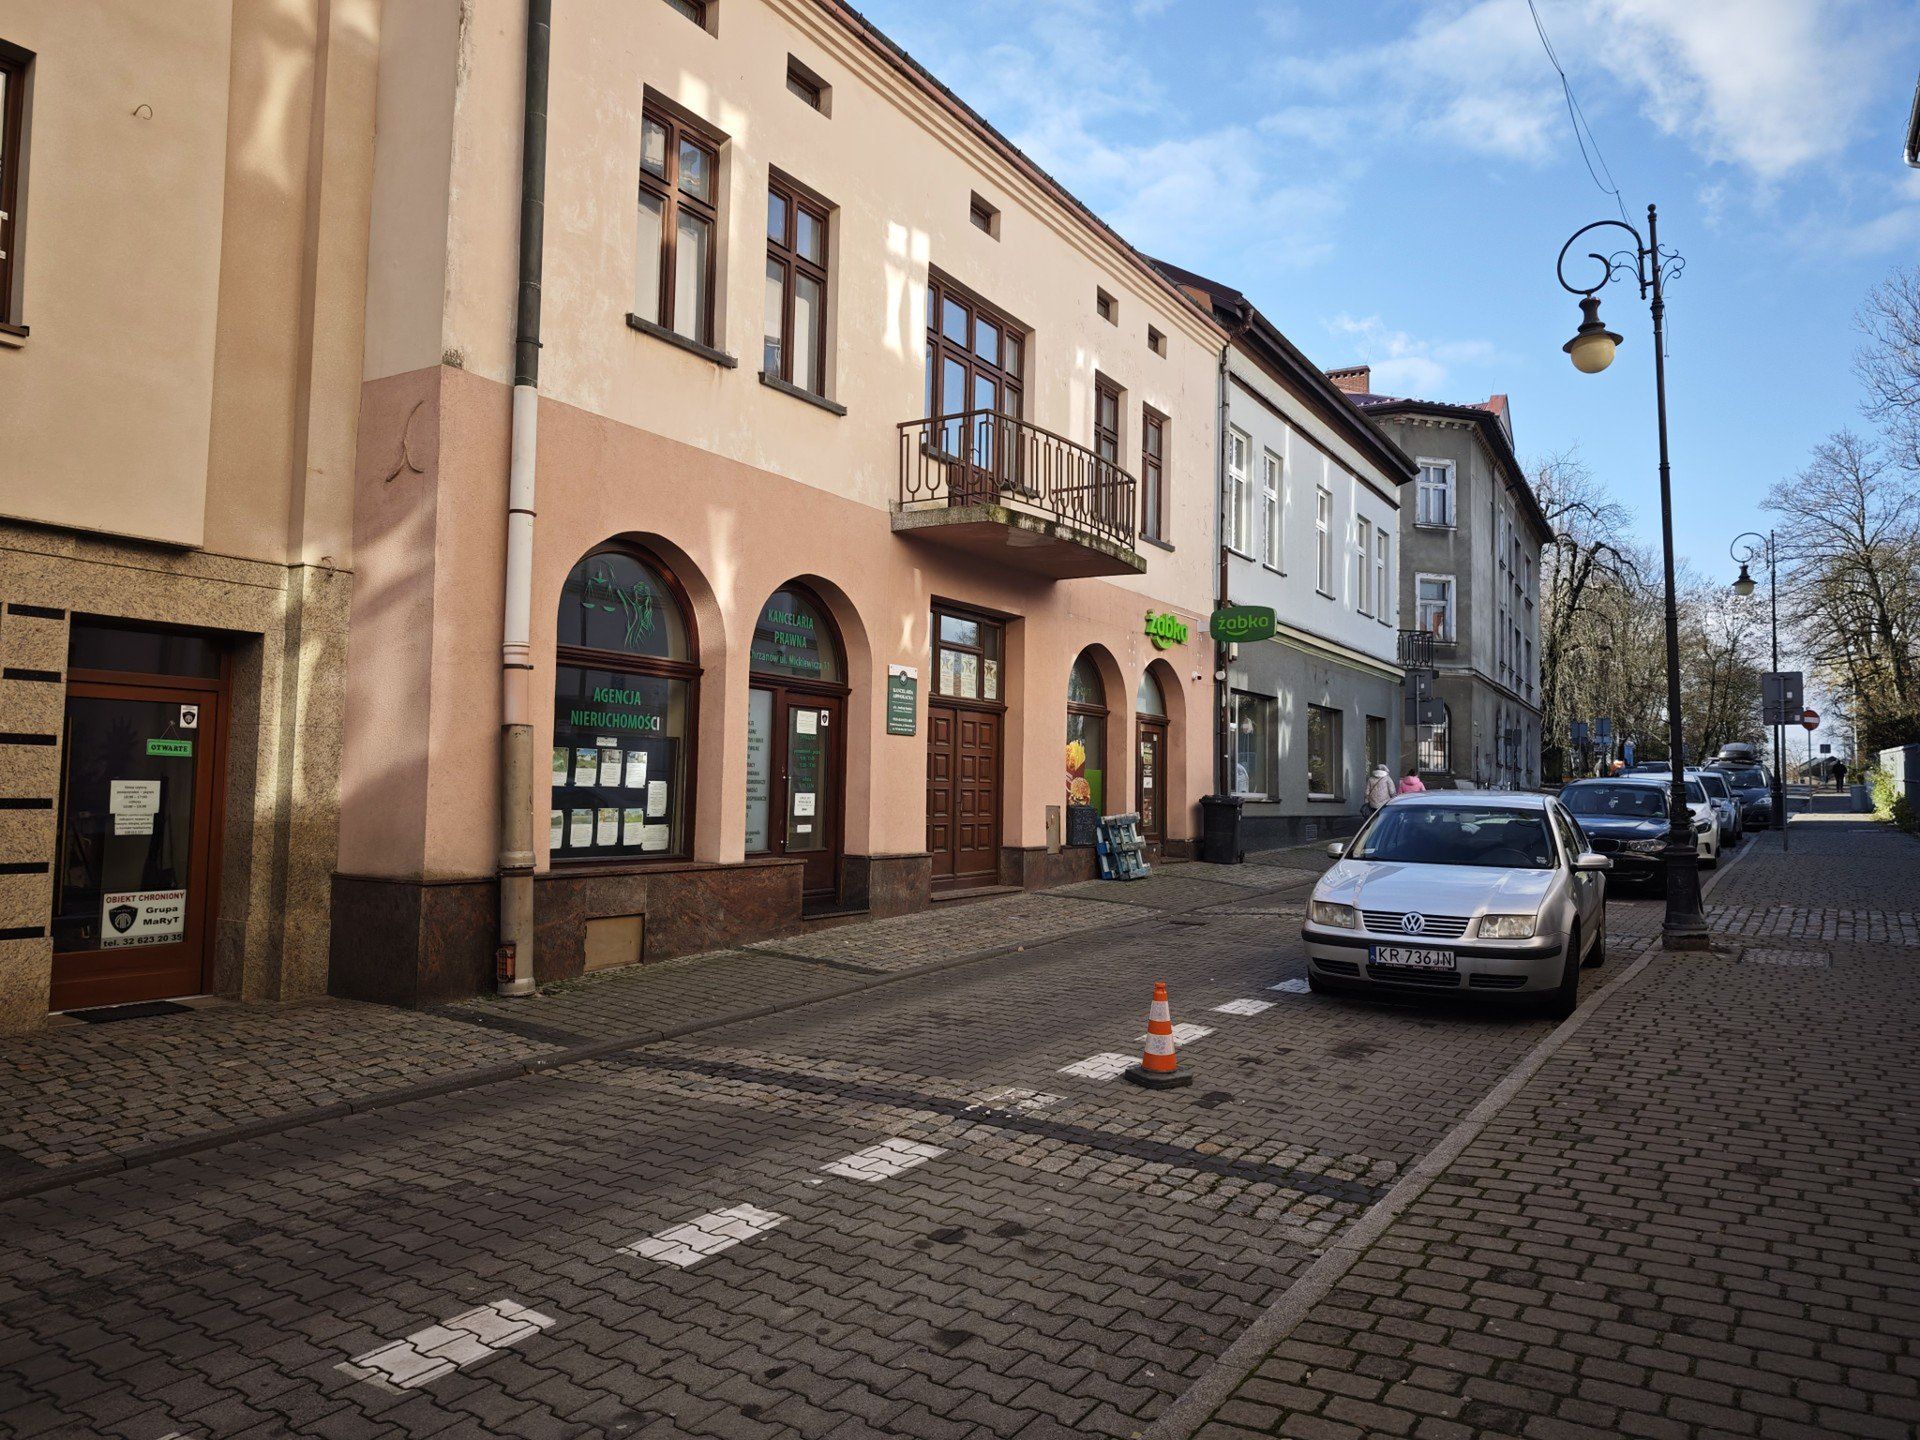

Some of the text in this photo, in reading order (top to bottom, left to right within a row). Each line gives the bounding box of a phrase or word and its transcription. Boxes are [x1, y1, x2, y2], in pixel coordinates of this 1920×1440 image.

[768, 608, 814, 630] KANCELARIA
[1145, 608, 1189, 643] żabka
[1218, 615, 1268, 630] żabka
[774, 630, 807, 648] PRAWNA
[593, 687, 641, 706] AGENCJA
[570, 710, 660, 731] NIERUCHOMOŚCI
[150, 744, 189, 752] OTWARTE
[105, 892, 185, 904] OBIEKT CHRONIONY
[145, 906, 178, 914] Grupa
[142, 916, 180, 926] MaRyT
[103, 939, 119, 947] tel.
[123, 937, 135, 946] 32
[137, 936, 155, 944] 623
[171, 933, 182, 941] 35
[1378, 947, 1452, 966] KR 736JN
